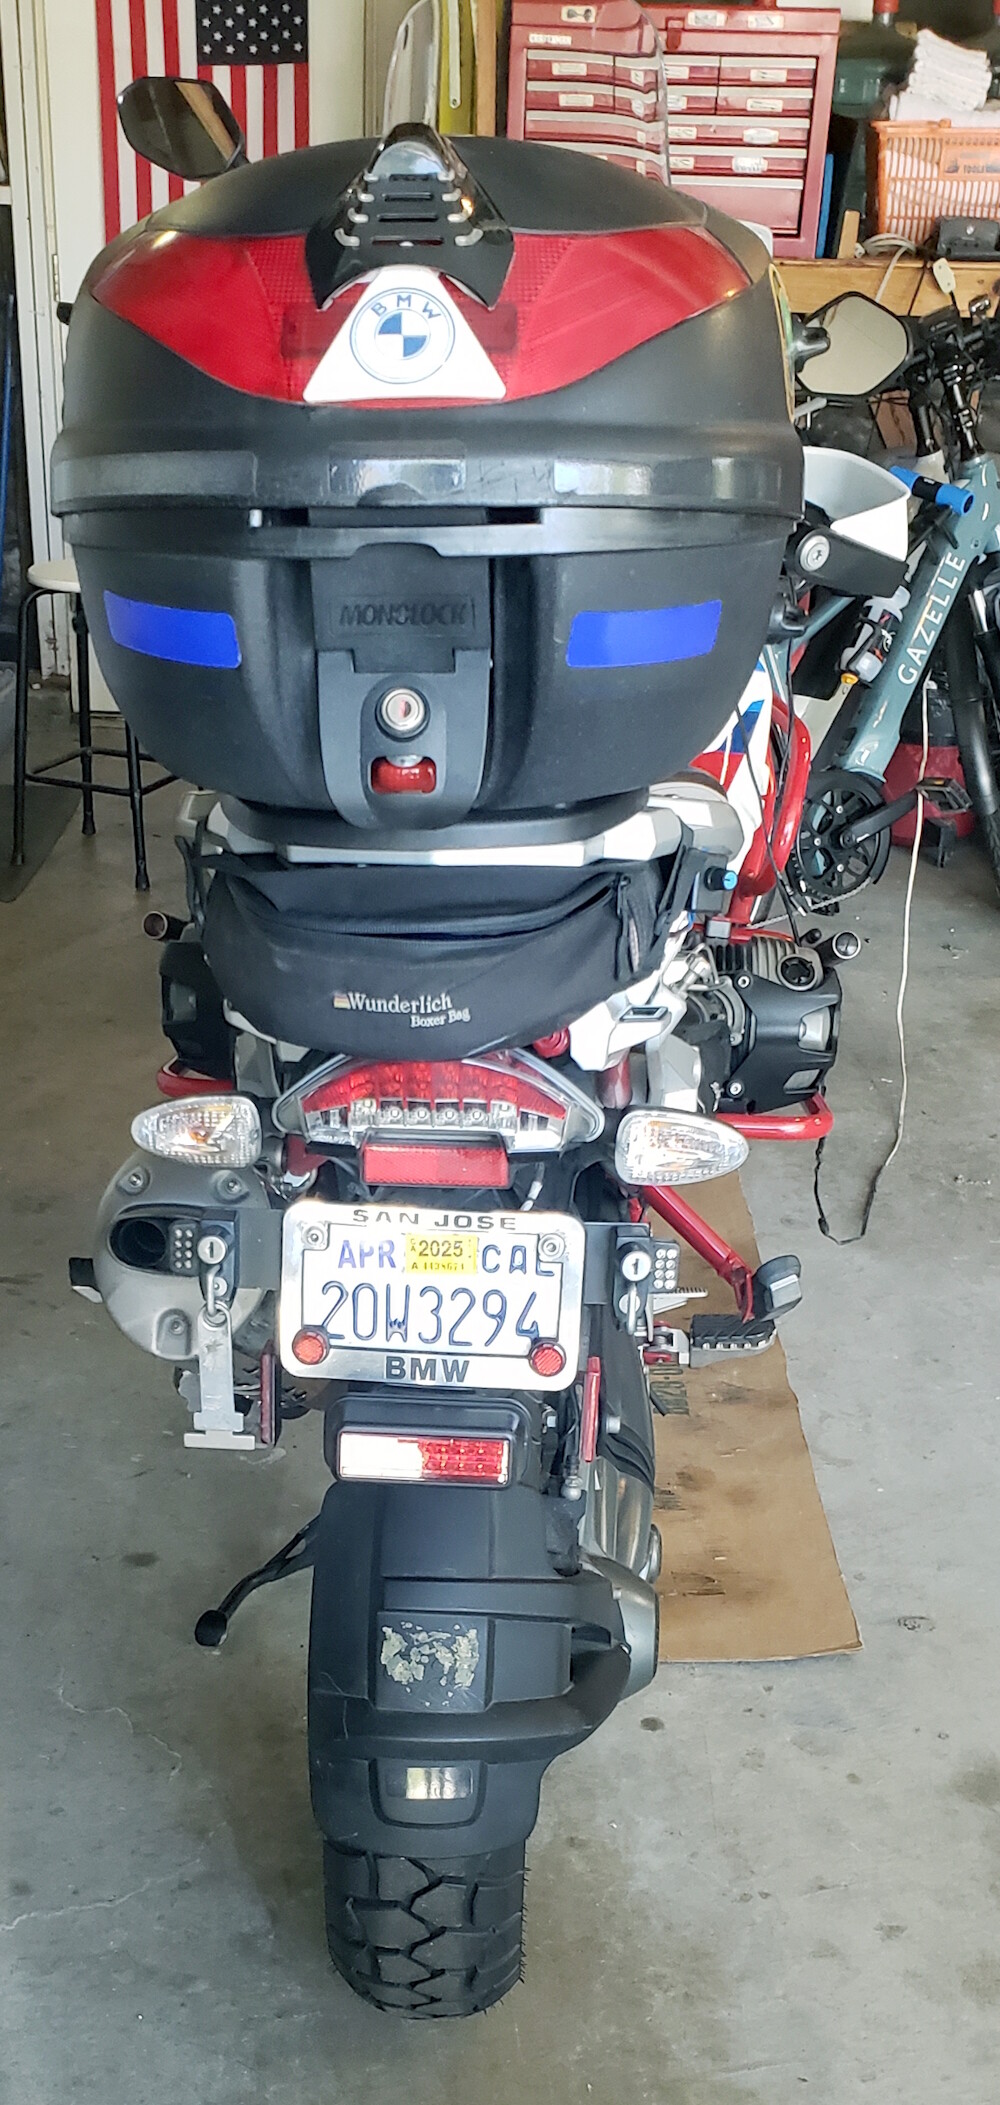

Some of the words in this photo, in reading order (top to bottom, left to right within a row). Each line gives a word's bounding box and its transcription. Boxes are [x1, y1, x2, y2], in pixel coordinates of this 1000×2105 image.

[370, 294, 442, 319] BMW
[338, 602, 468, 627] MONOLOCK
[897, 551, 966, 685] GAZELLE
[348, 991, 453, 1014] Wunderlich
[410, 1014, 447, 1028] Boxer
[448, 1007, 471, 1023] Bag
[352, 1209, 419, 1225] SAN
[434, 1213, 516, 1231] JOSE
[337, 1239, 397, 1269] APR
[418, 1239, 464, 1258] 2025
[321, 1280, 541, 1348] 20W3294
[385, 1355, 470, 1384] BMW
